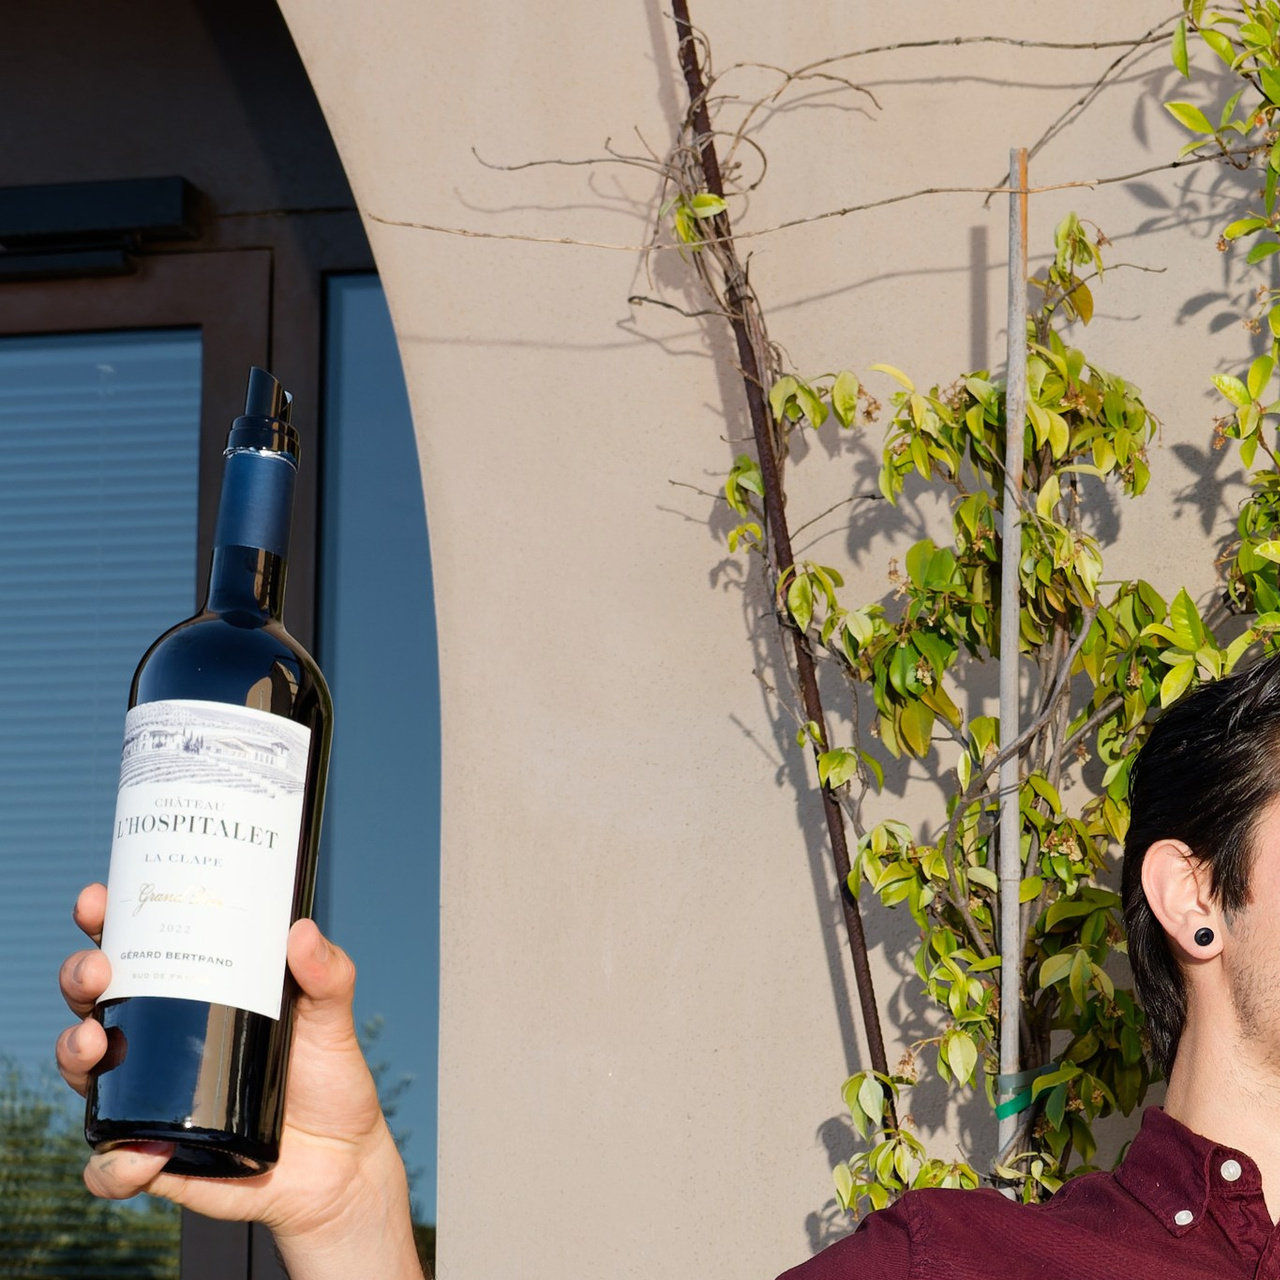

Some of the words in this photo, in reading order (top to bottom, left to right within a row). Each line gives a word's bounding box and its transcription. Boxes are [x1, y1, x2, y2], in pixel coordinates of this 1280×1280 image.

[154, 795, 226, 812] CHÂTEAU
[117, 813, 279, 850] L'HOSPITALET
[144, 853, 162, 863] LA
[169, 854, 224, 868] CLAPE
[158, 923, 192, 935] 2022
[120, 950, 162, 961] GÉRARD
[165, 952, 234, 968] BERTRAND
